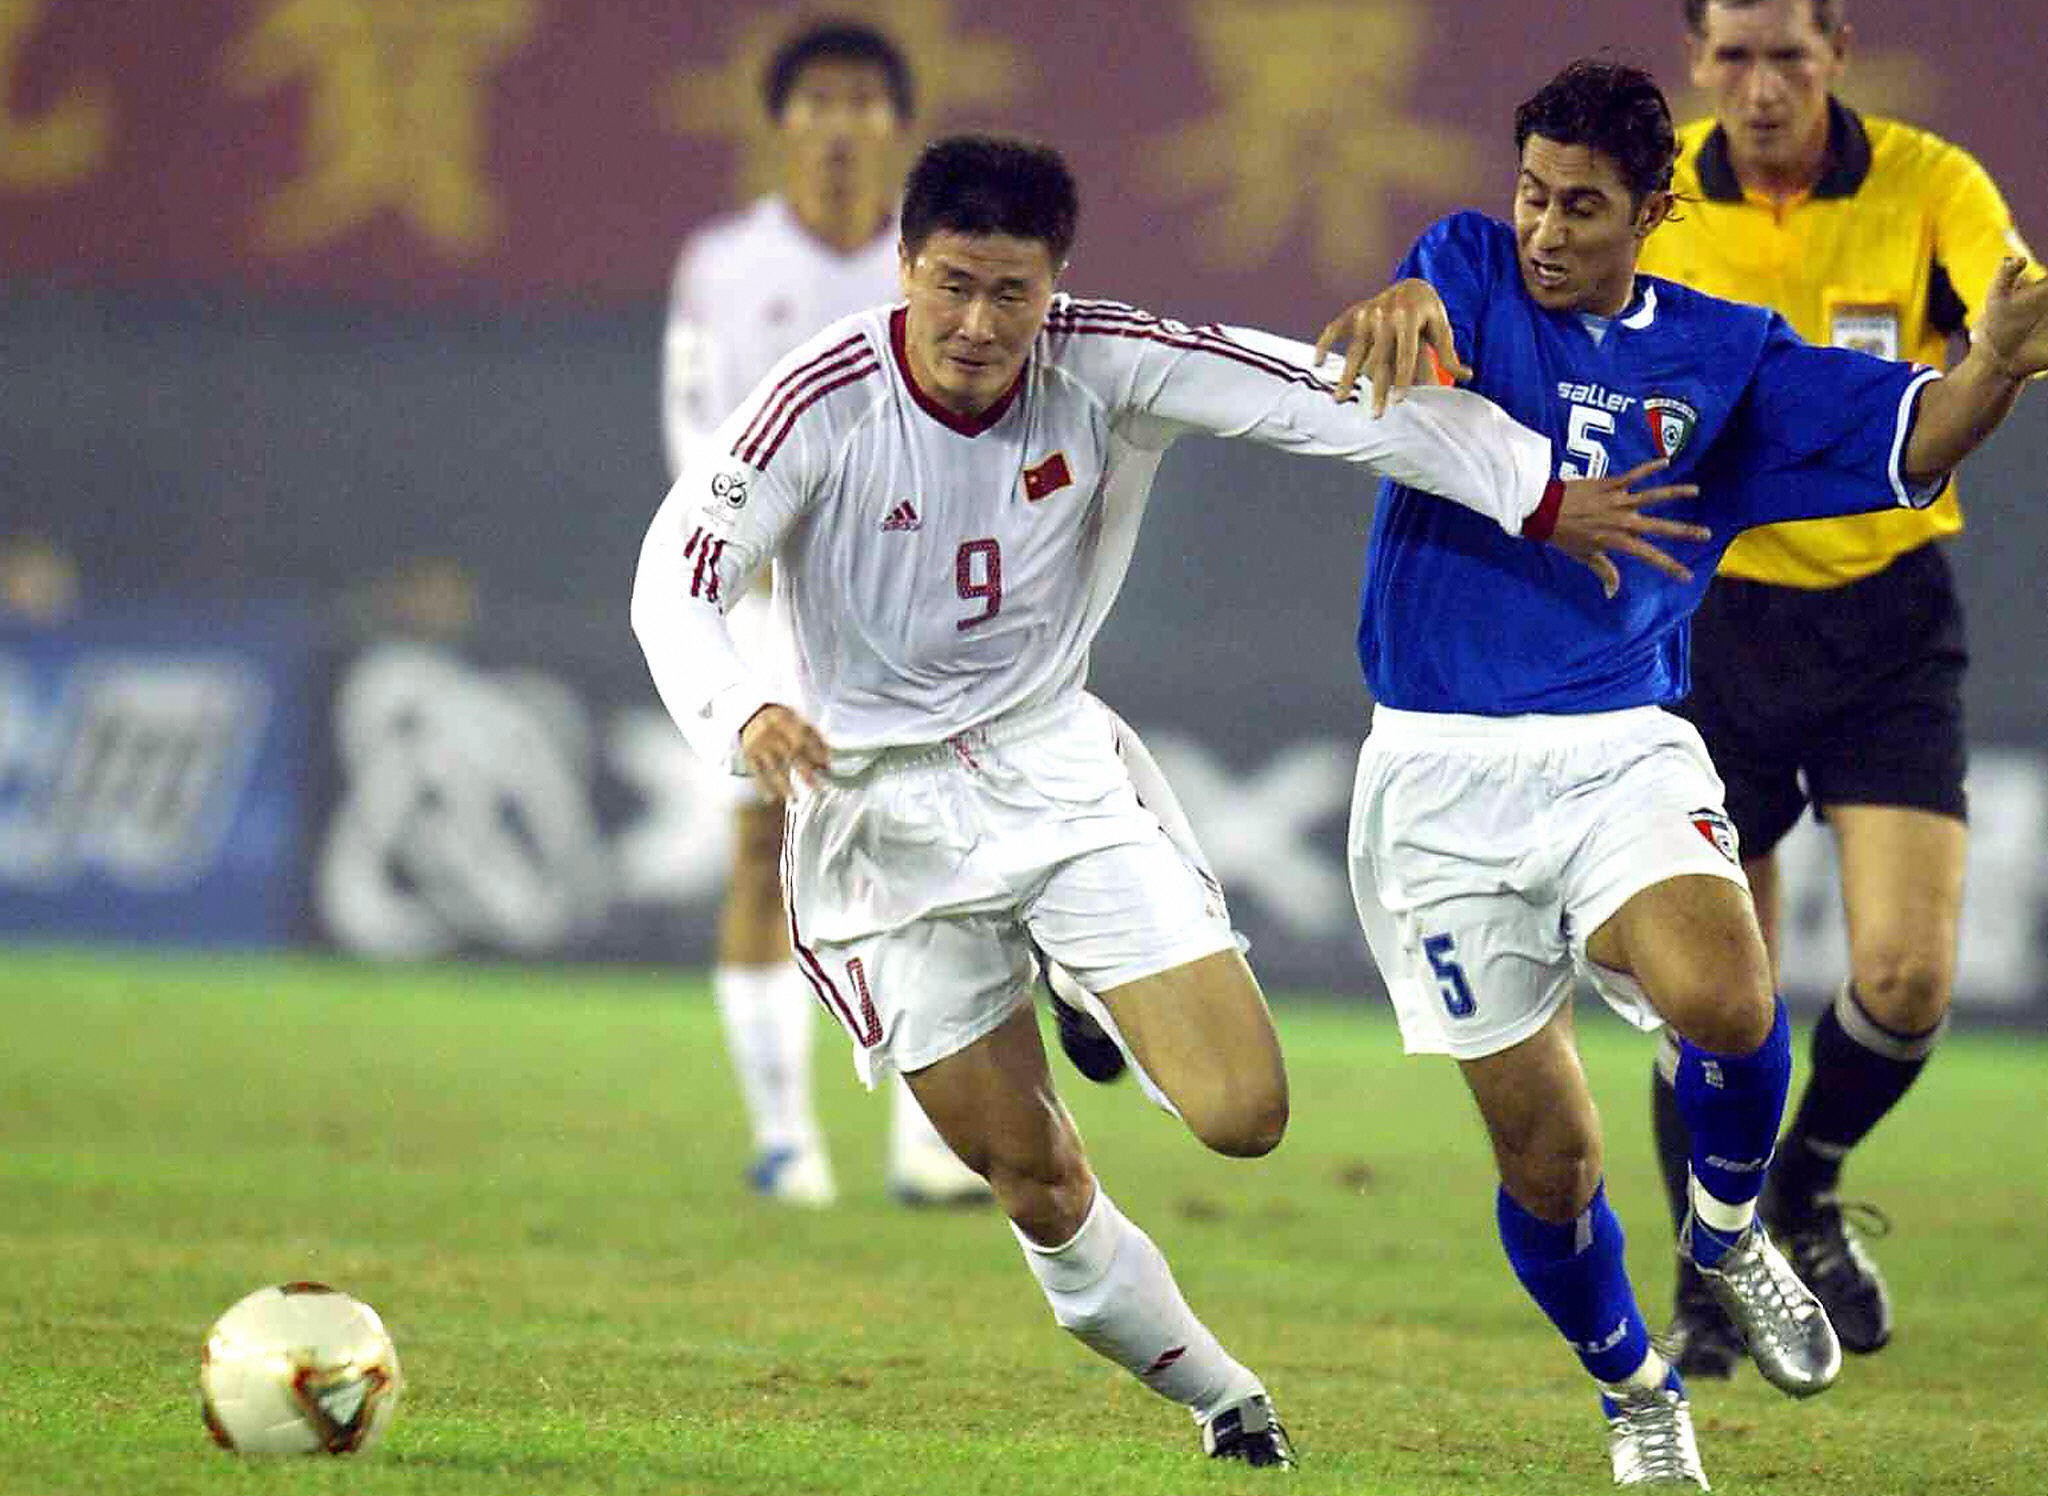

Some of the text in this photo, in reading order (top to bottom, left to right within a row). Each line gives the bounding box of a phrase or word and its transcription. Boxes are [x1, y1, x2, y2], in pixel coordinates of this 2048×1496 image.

[1557, 381, 1637, 414] saller
[1559, 403, 1615, 481] 5
[956, 538, 1002, 632] 9
[1423, 931, 1478, 1019] 5
